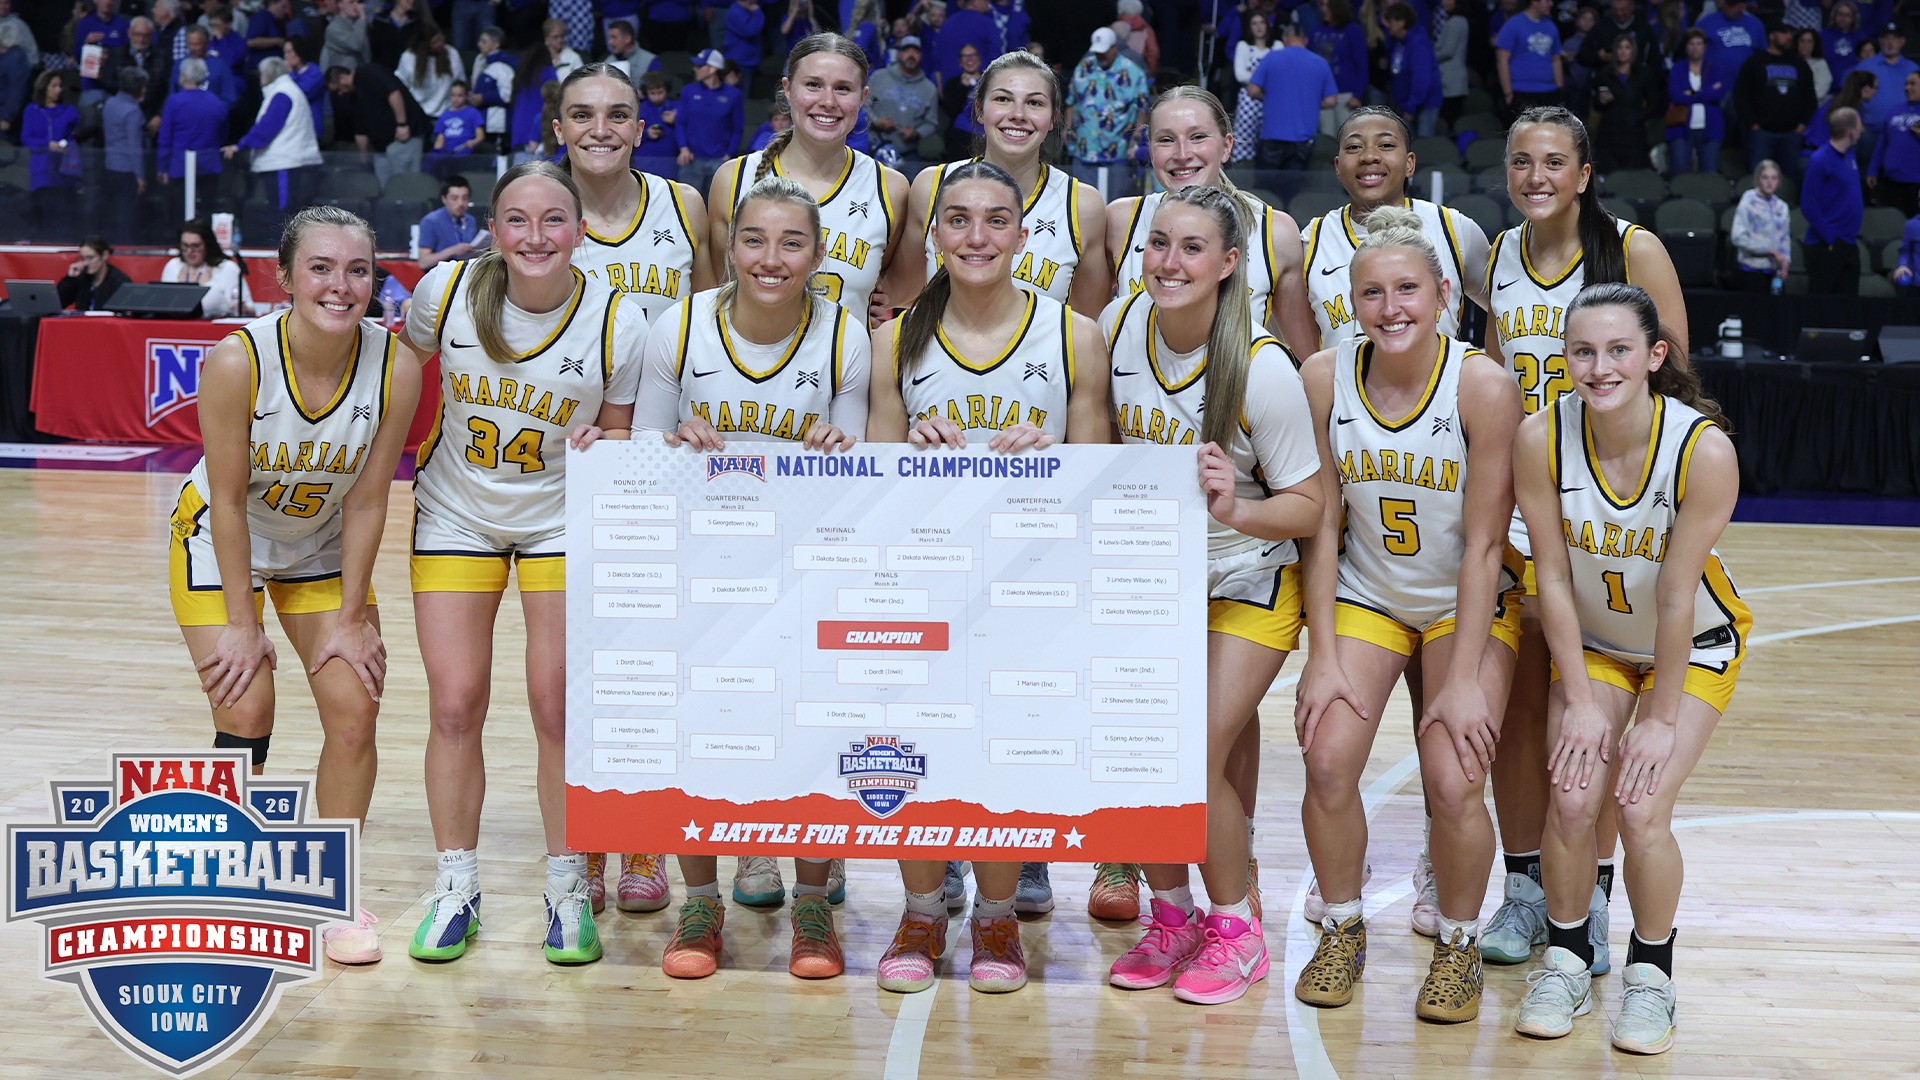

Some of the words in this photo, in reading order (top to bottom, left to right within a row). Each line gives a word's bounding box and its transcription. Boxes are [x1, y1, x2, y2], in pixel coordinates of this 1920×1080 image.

[1513, 352, 1575, 415] 22
[449, 372, 580, 427] MARIAN
[465, 415, 546, 474] 34
[709, 456, 764, 478] NAIA
[776, 456, 884, 477] NATIONAL
[898, 456, 1061, 478] CHAMPIONSHIP
[1338, 449, 1459, 492] MARIAN
[257, 480, 333, 518] 15
[705, 494, 760, 502] QUARTERFINALS
[712, 519, 745, 527] Georgetown
[1379, 496, 1421, 556] 5
[614, 533, 647, 542] Georgetown
[1601, 570, 1633, 614] 1
[845, 631, 924, 644] CHAMPION
[867, 737, 898, 748] NAIA
[1109, 735, 1128, 743] Spring
[1011, 749, 1050, 757] Campbellsville
[842, 756, 923, 774] BASKETBALL
[1110, 765, 1149, 773] Campbellsville
[850, 779, 915, 788] CHAMPIONSHIP
[708, 822, 802, 844] BATTLE
[802, 824, 850, 845] FOR
[854, 825, 903, 846] THE
[904, 826, 954, 847] RED
[954, 826, 1056, 848] BANNER
